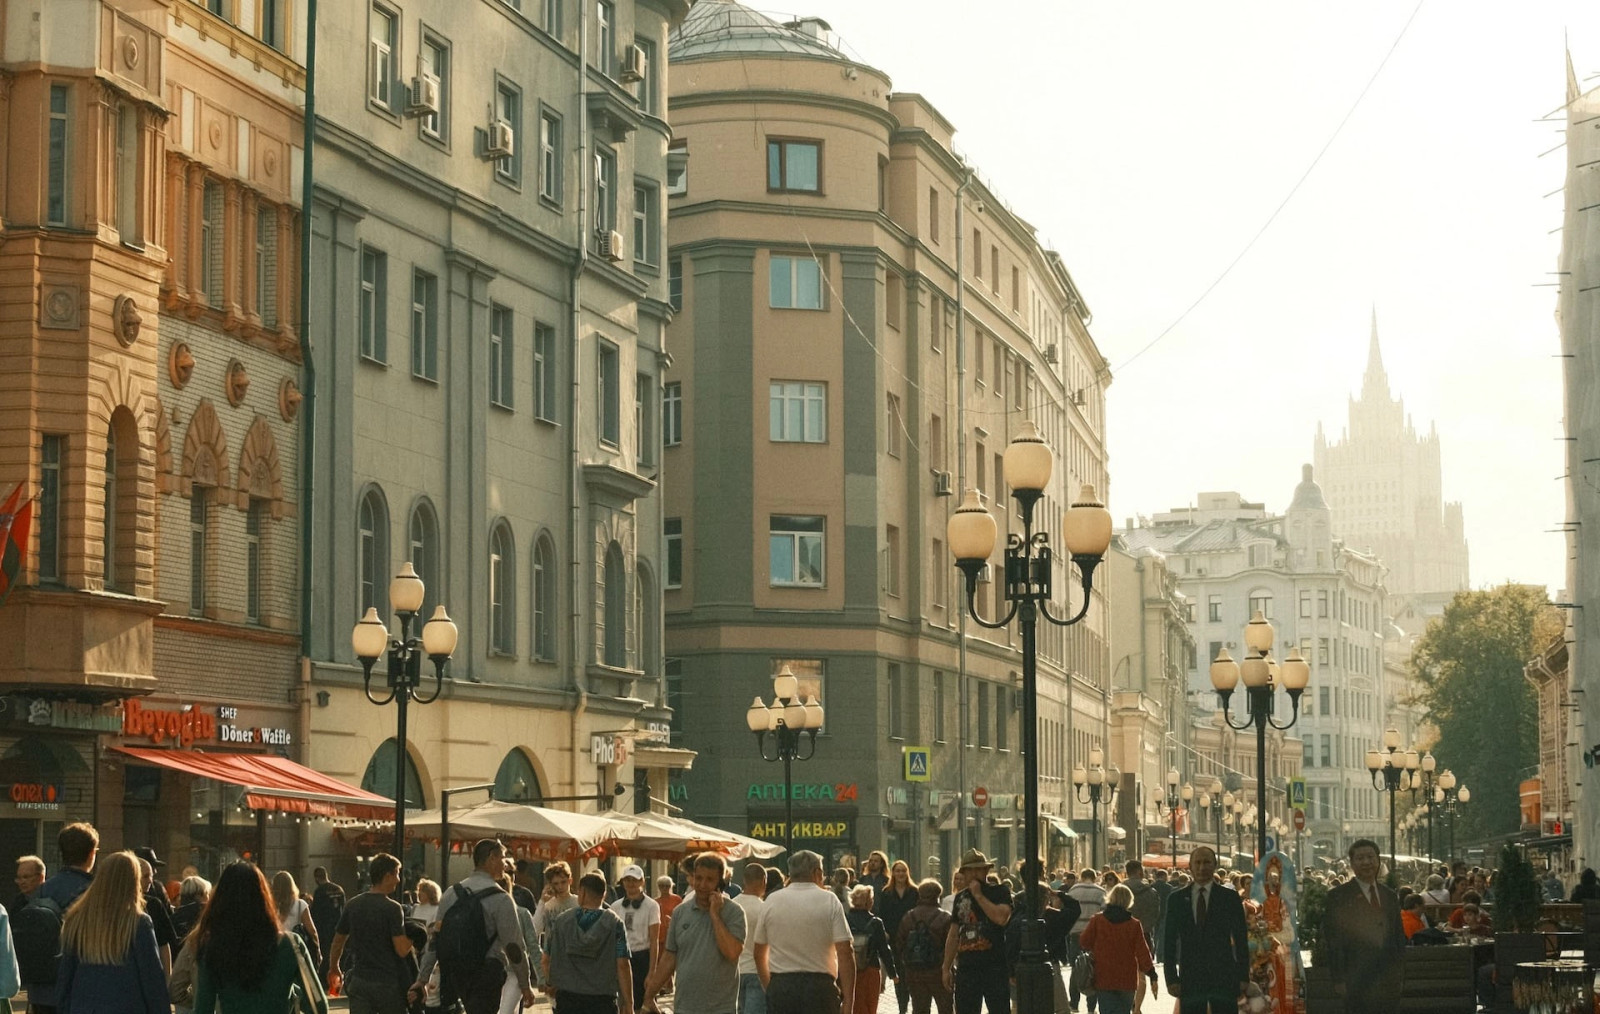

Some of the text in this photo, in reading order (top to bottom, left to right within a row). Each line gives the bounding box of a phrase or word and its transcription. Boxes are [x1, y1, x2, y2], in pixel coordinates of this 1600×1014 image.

[220, 706, 238, 720] SHEF
[221, 724, 252, 743] Döner
[261, 728, 291, 745] Waffle
[747, 782, 858, 803] АПТЕКА 24
[751, 822, 847, 838] АНТИКВАР
